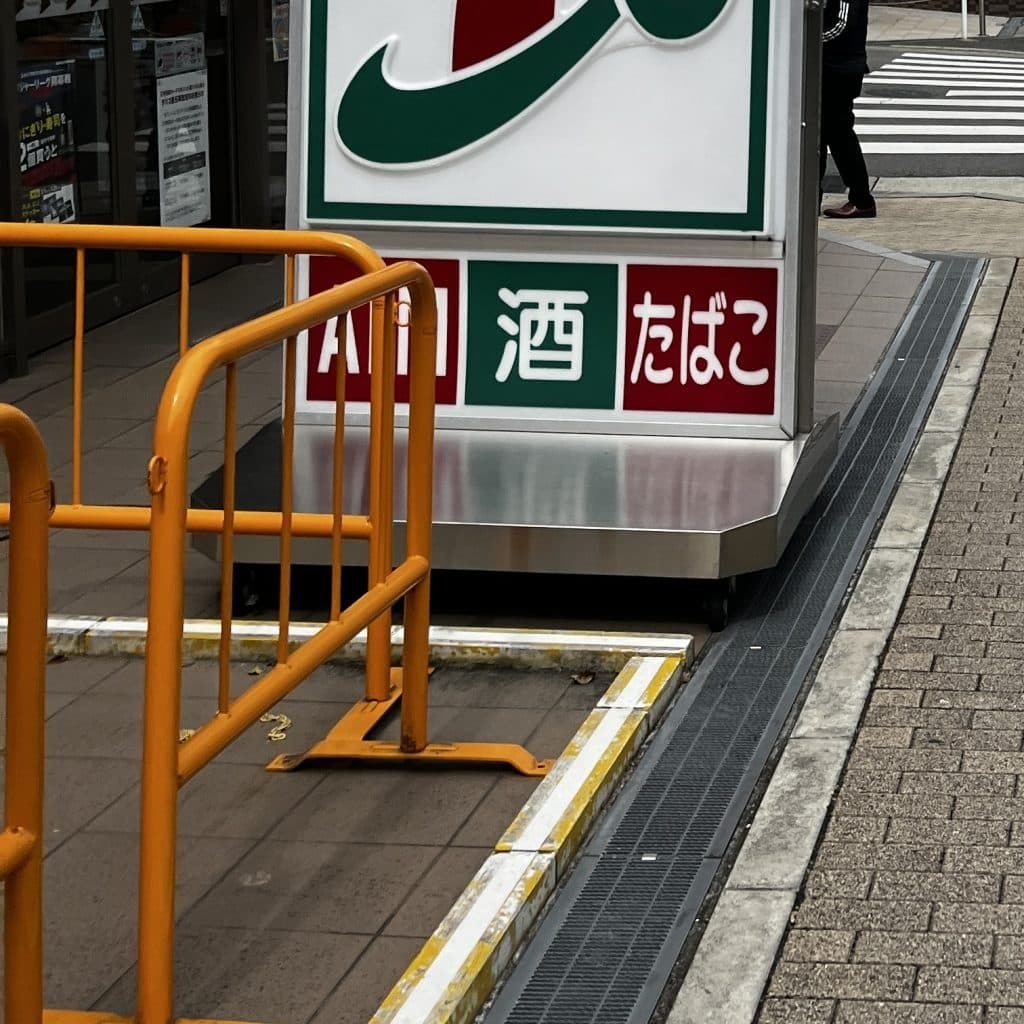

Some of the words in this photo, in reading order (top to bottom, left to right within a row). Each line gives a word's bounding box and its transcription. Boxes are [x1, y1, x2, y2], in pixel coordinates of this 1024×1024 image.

[495, 287, 589, 382] 酒
[630, 290, 769, 386] たばこ
